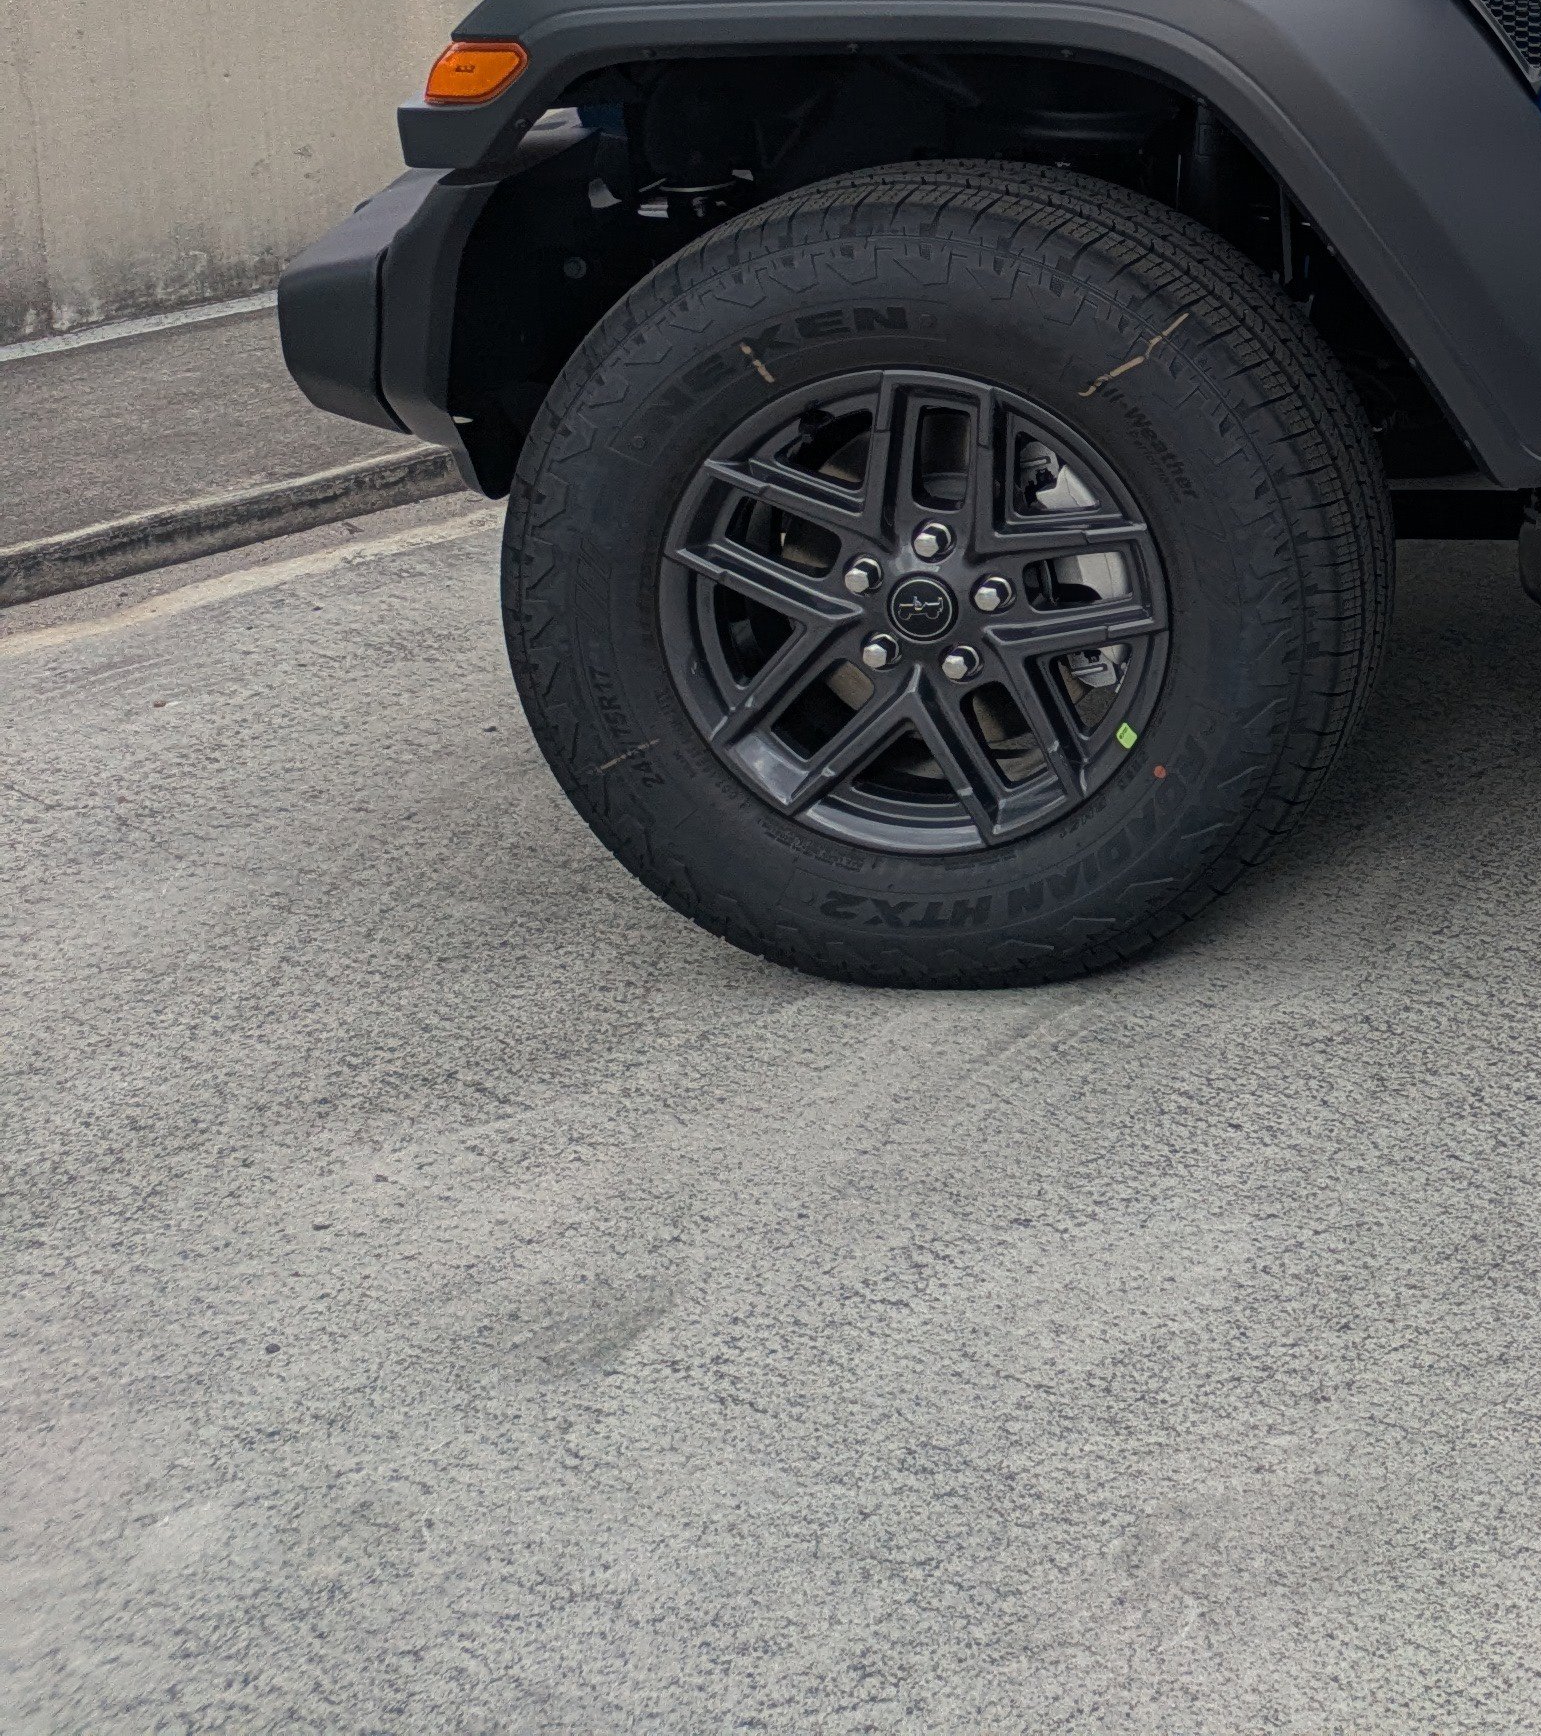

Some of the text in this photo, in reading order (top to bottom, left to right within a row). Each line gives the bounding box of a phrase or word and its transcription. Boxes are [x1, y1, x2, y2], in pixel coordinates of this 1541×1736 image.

[643, 305, 908, 432] NEXEN
[1006, 734, 1211, 917] ROADIAN
[820, 889, 994, 928] HTX2
